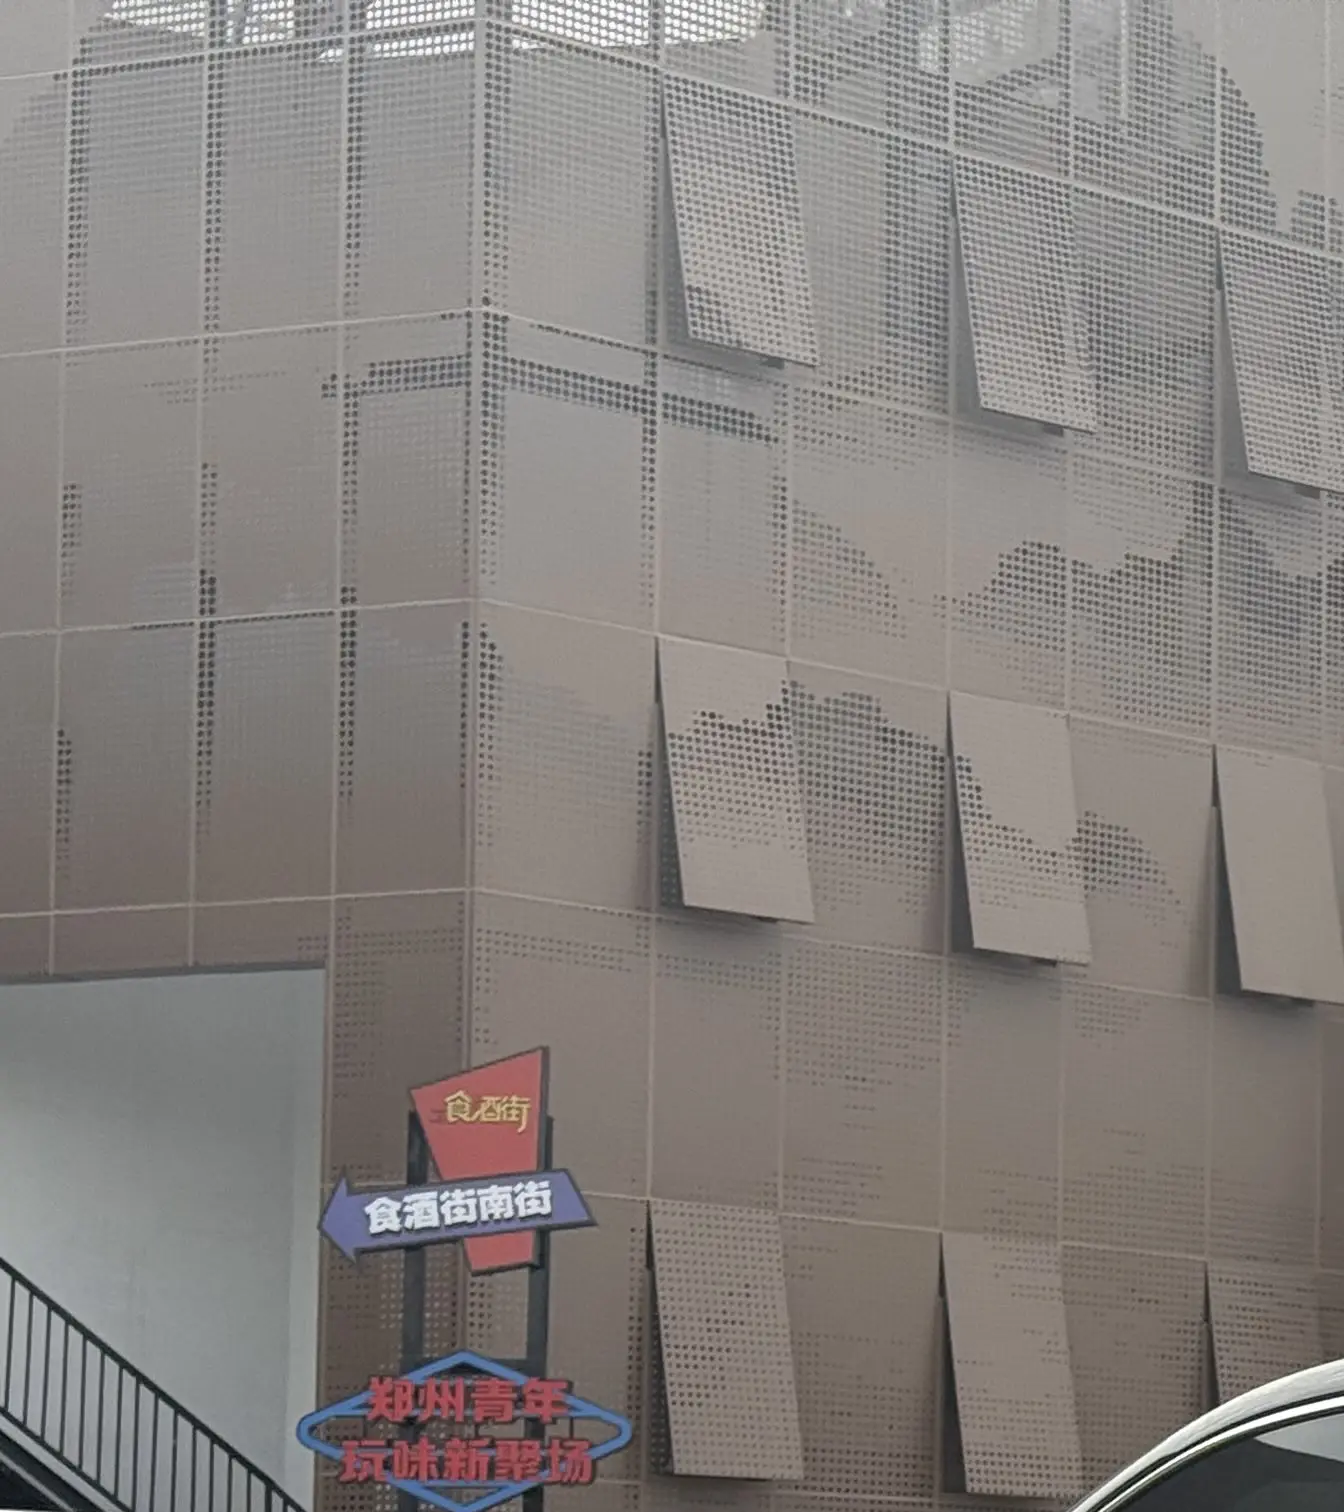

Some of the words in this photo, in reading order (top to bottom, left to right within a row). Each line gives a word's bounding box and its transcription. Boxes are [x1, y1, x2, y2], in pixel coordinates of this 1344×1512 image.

[364, 1180, 552, 1235] 食酒街南街
[366, 1376, 570, 1423] 郑州青年
[339, 1438, 594, 1484] 玩味新聚场
